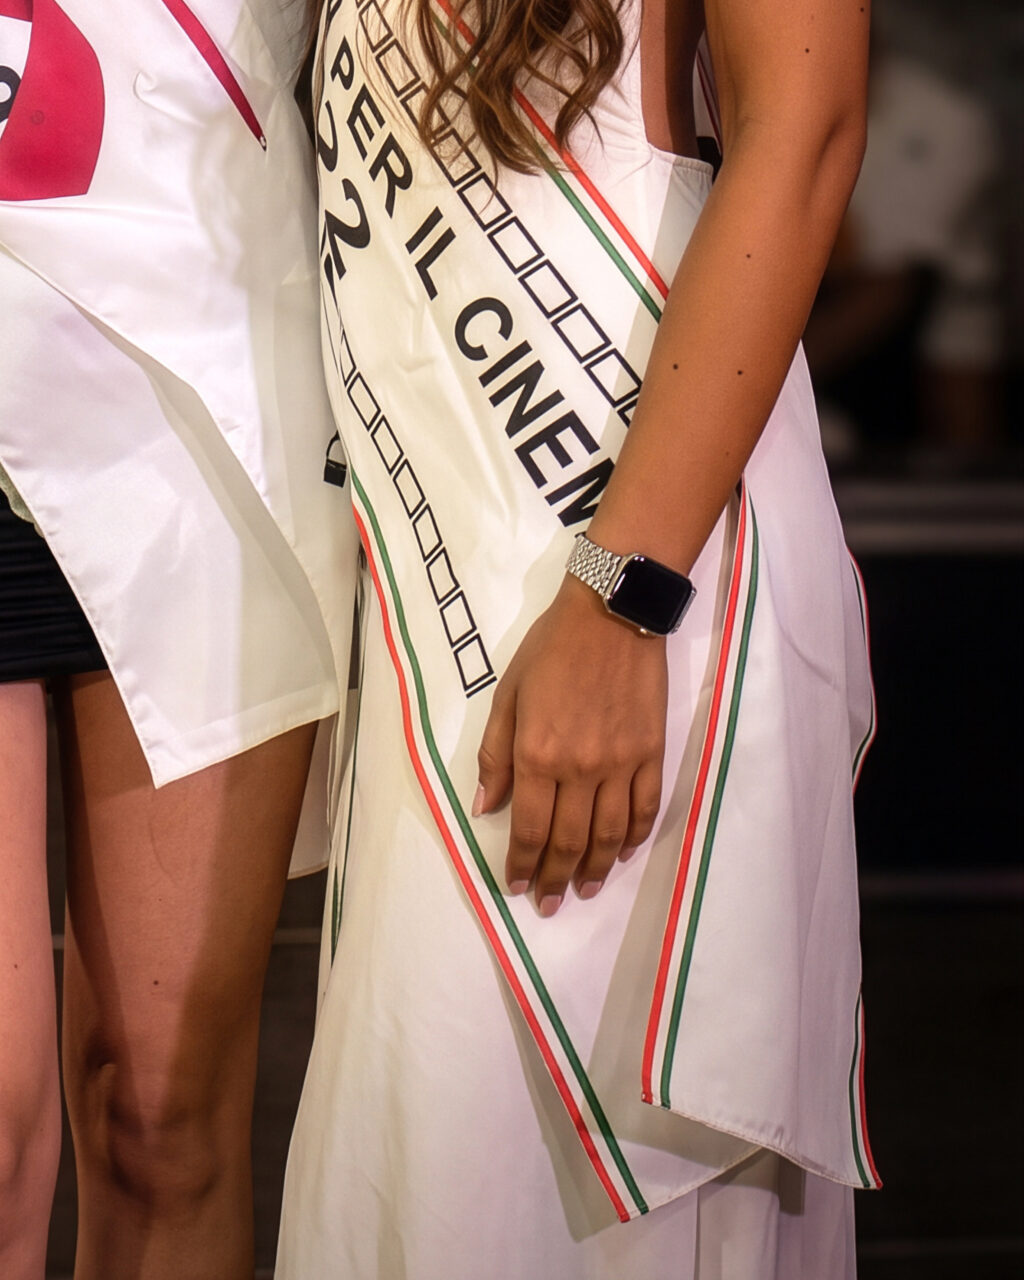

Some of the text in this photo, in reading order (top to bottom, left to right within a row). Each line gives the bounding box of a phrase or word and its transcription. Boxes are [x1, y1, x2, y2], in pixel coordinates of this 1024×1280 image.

[330, 35, 414, 220] PER
[404, 205, 458, 302] IL
[454, 296, 617, 538] CINEM
